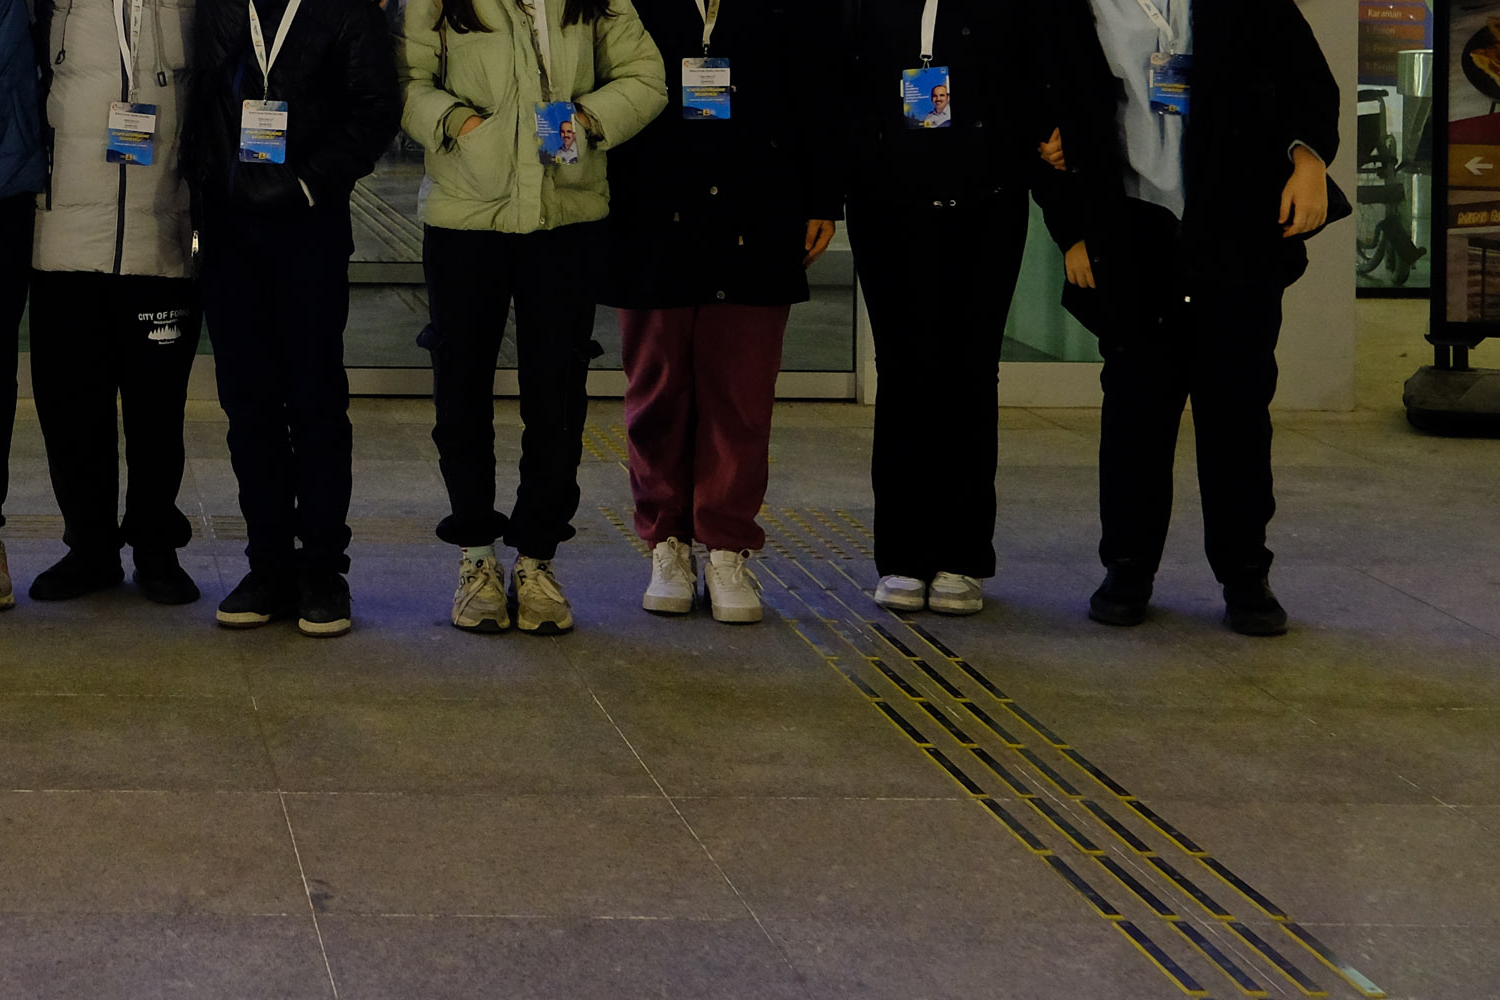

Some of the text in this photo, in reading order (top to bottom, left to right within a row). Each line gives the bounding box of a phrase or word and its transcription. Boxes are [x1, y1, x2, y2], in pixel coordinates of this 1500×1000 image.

[1367, 8, 1402, 18] Karaman
[138, 312, 154, 321] CITY
[156, 311, 168, 320] OF
